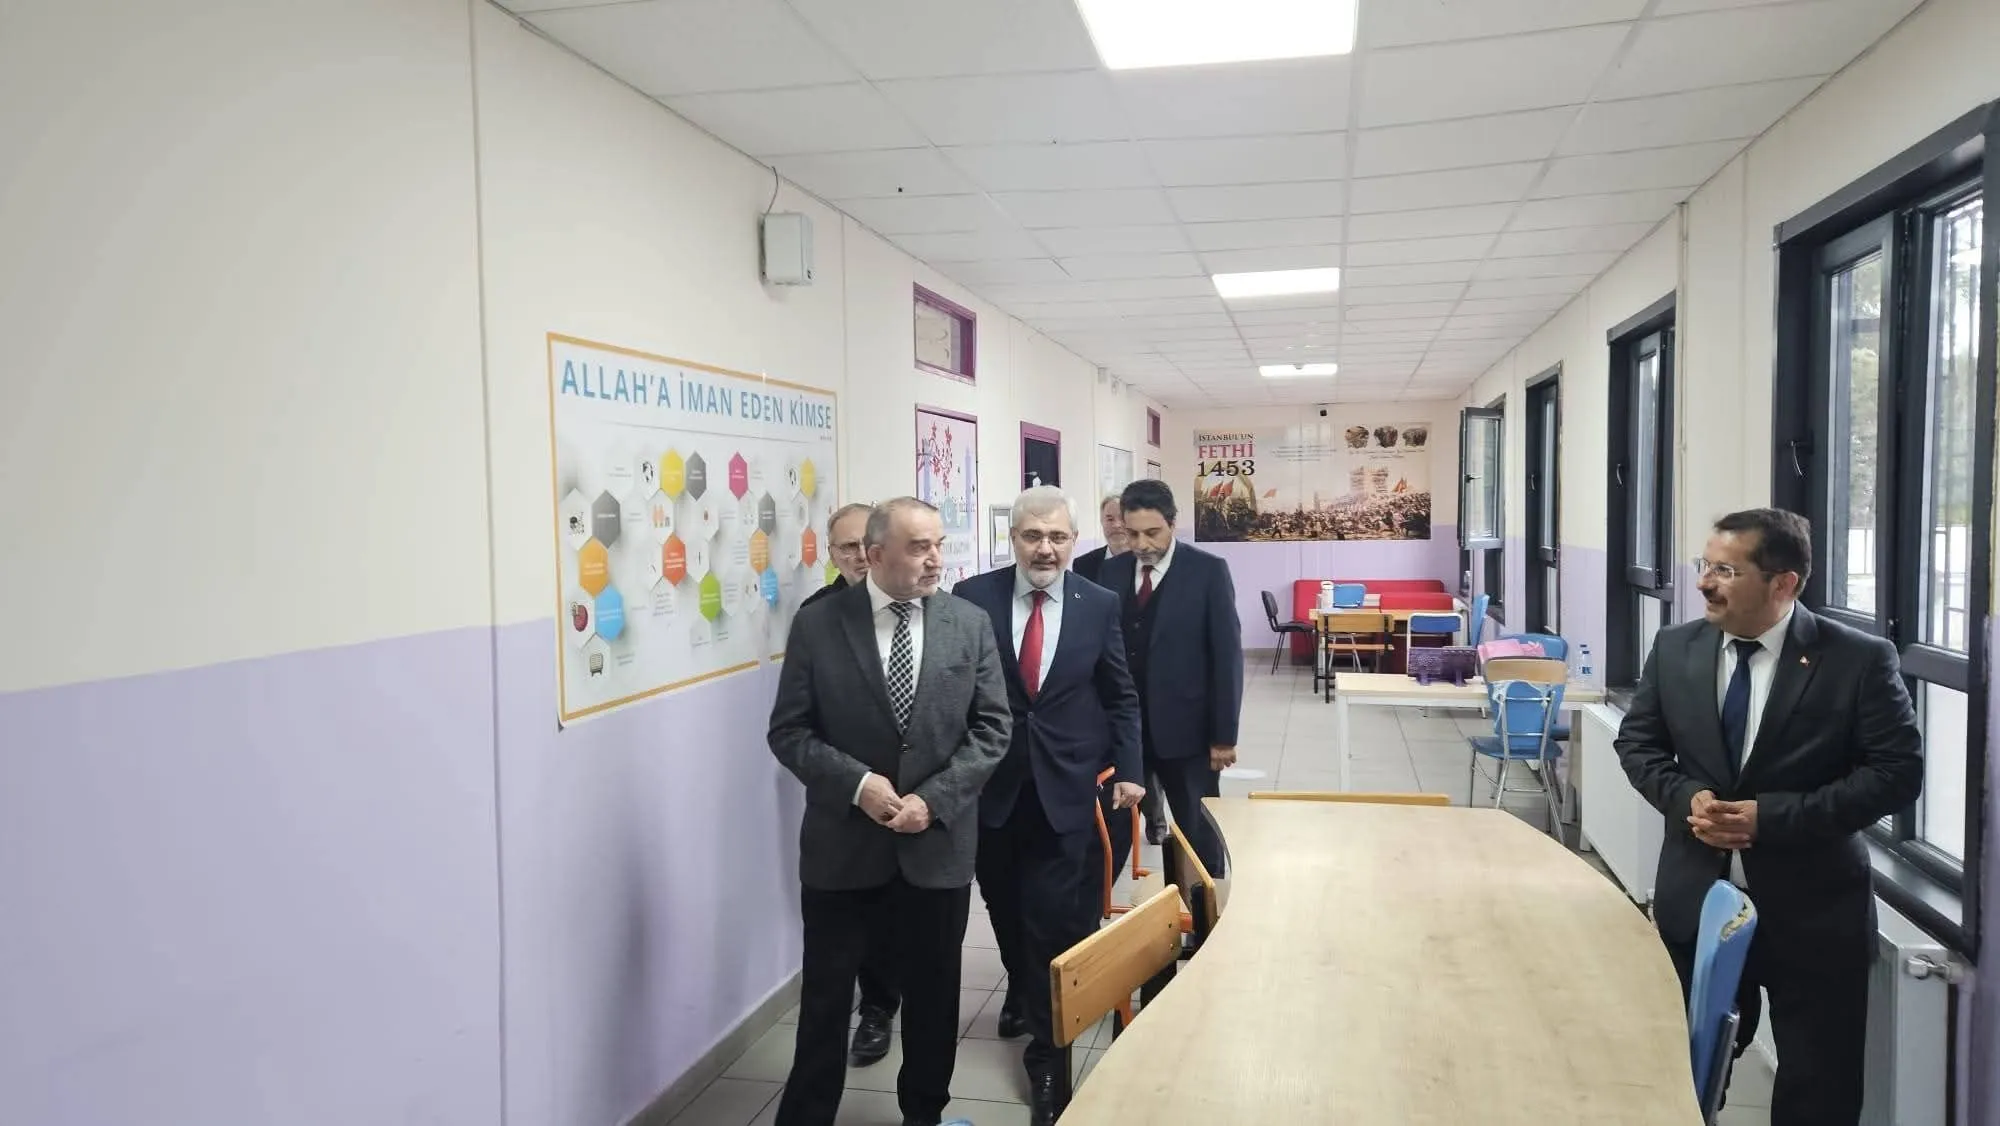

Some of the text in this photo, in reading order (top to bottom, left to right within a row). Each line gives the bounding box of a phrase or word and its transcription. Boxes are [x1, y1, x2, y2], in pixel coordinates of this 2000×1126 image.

[562, 359, 832, 429] ALLAH'A İMAN EDEN KİMSE
[1199, 440, 1254, 459] FETHİ
[1198, 460, 1255, 477] 1453
